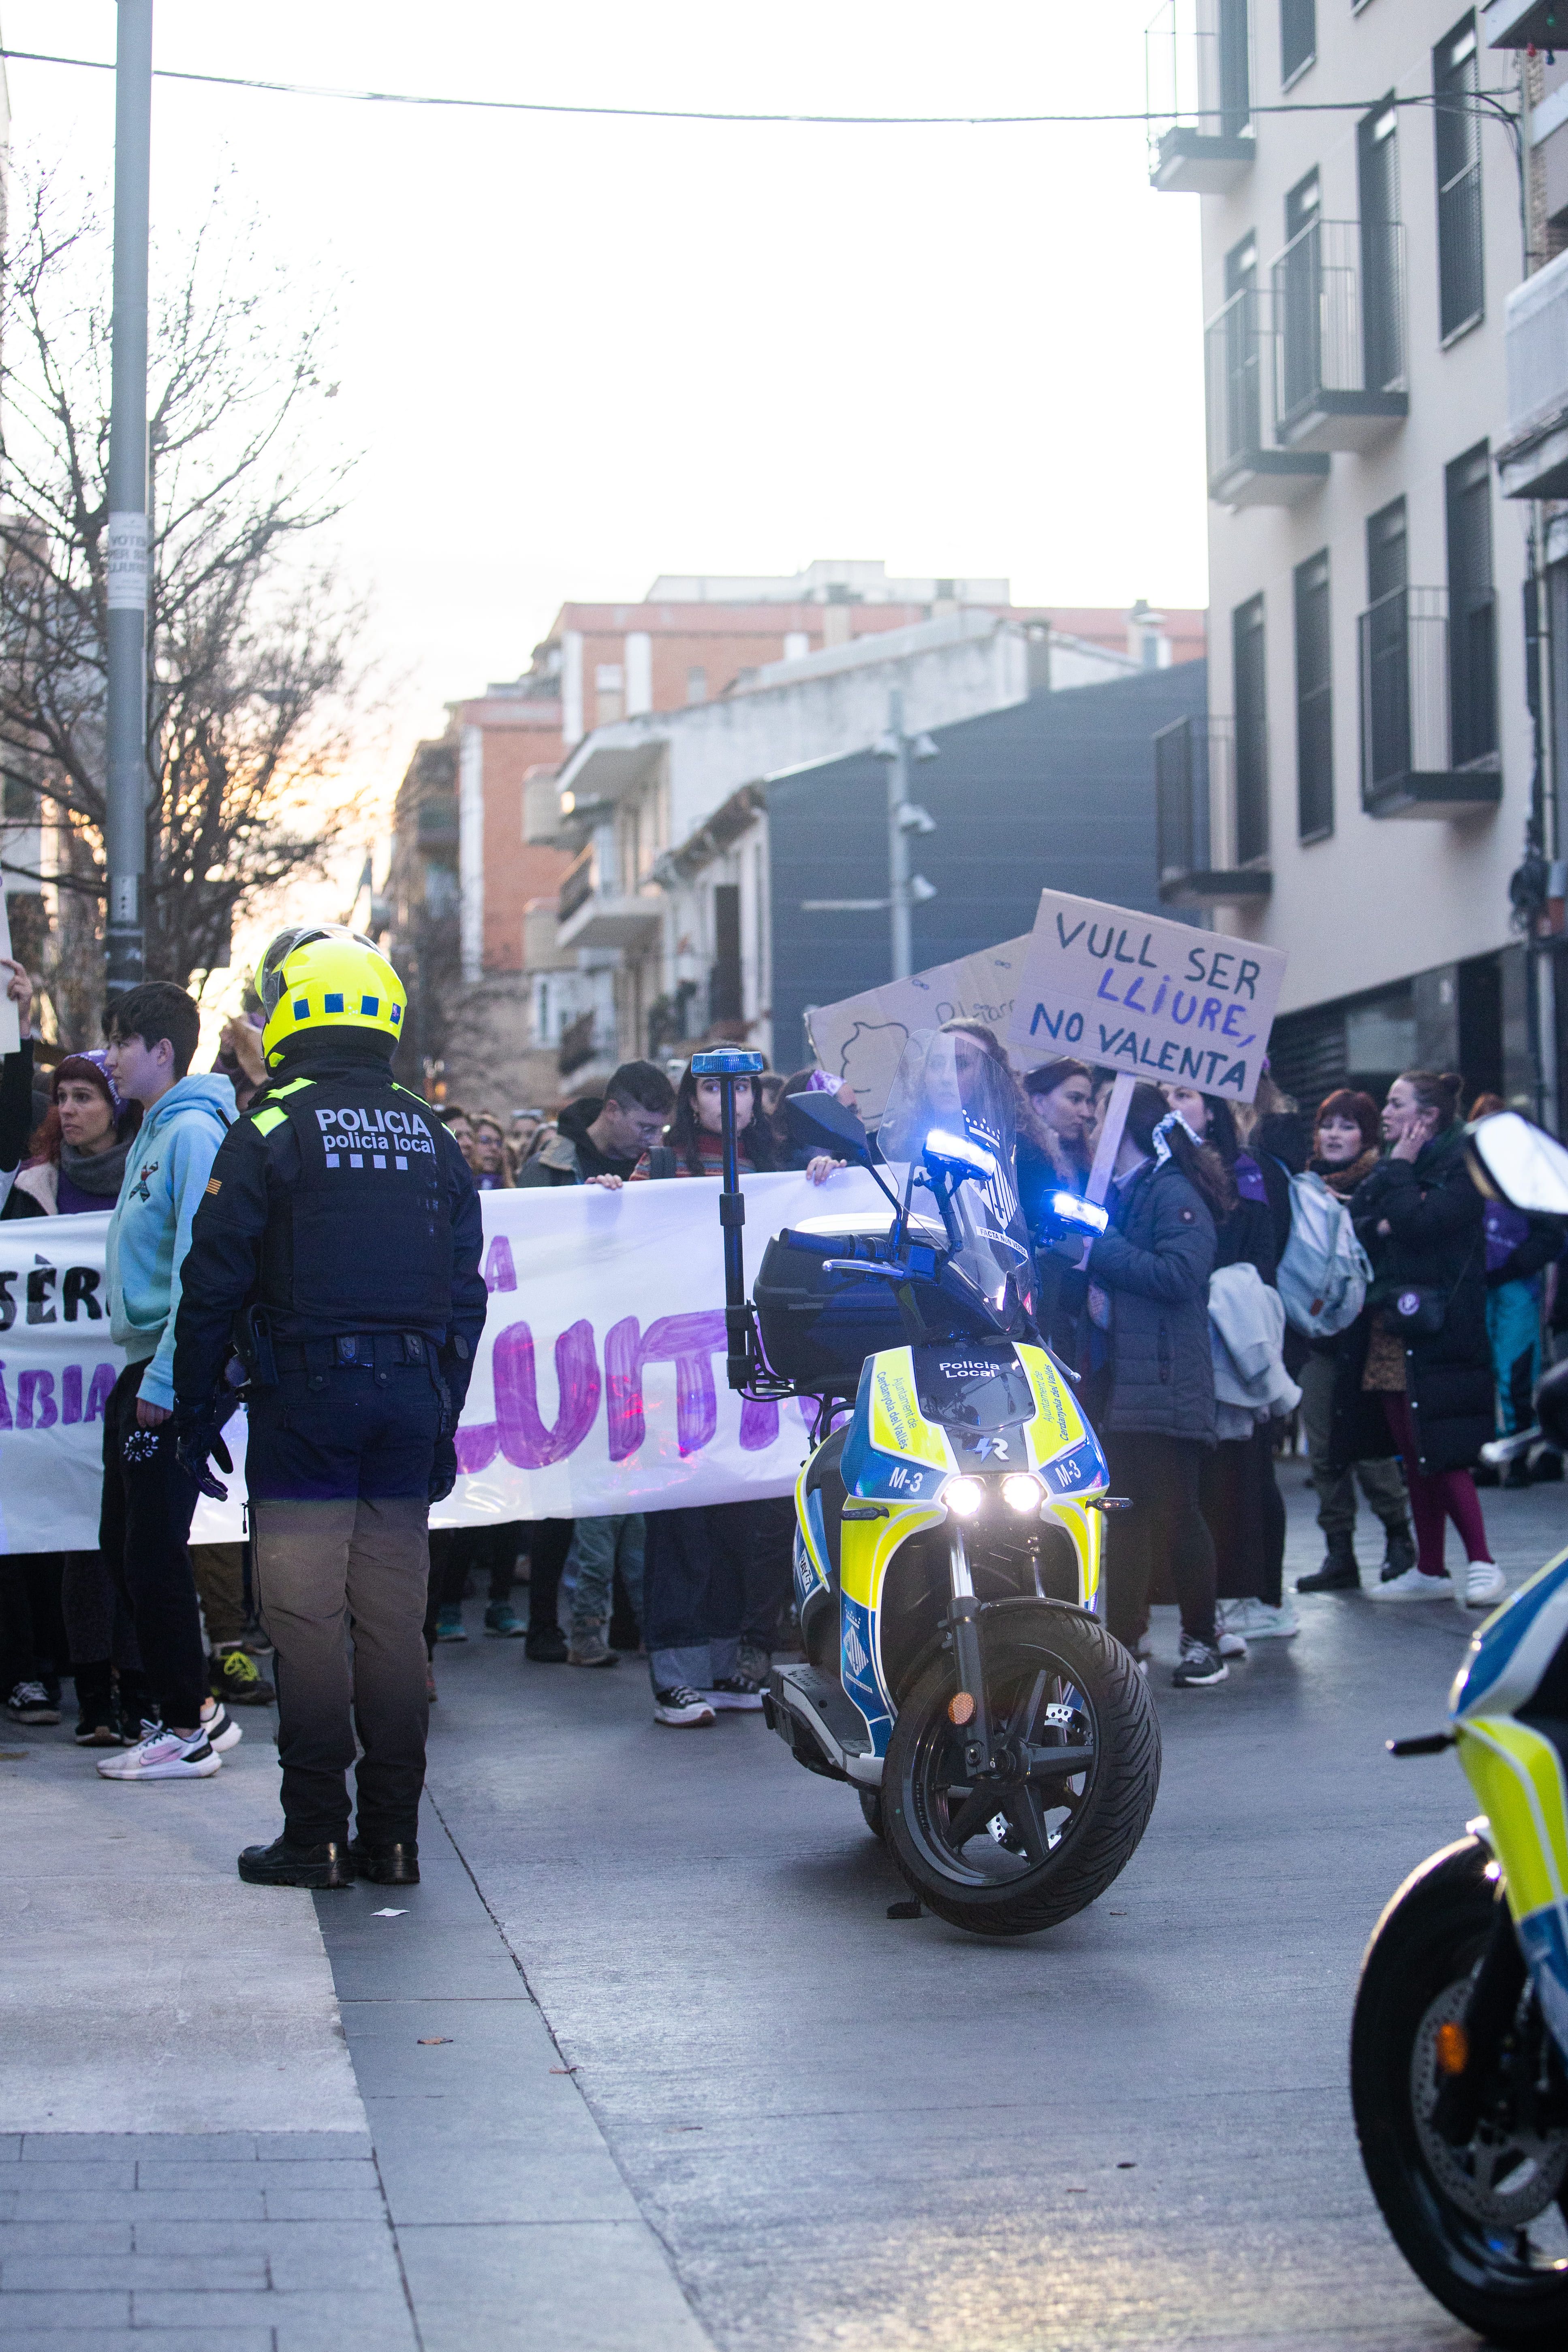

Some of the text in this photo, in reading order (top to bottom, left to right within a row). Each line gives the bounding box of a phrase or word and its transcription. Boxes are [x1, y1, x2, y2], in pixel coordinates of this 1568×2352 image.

[1056, 912, 1260, 1000] VULL SER
[1029, 1002, 1084, 1042] NO
[1099, 1024, 1247, 1092] VALENTA
[315, 1108, 432, 1138] POLICIA
[323, 1132, 436, 1154] policia local
[980, 1228, 1026, 1255] FACTA NON VERBA
[0, 1254, 111, 1331] SÈR
[939, 1361, 1000, 1371] Policia
[945, 1369, 995, 1378] Local
[877, 1371, 909, 1449] Cerdanyola del Vallès
[892, 1377, 919, 1429] Ajuntament de
[1034, 1370, 1054, 1423] Ajuntament de
[1044, 1364, 1069, 1441] Cerdanyola del Vallès
[889, 1467, 923, 1492] M-3
[1055, 1459, 1081, 1487] M-3
